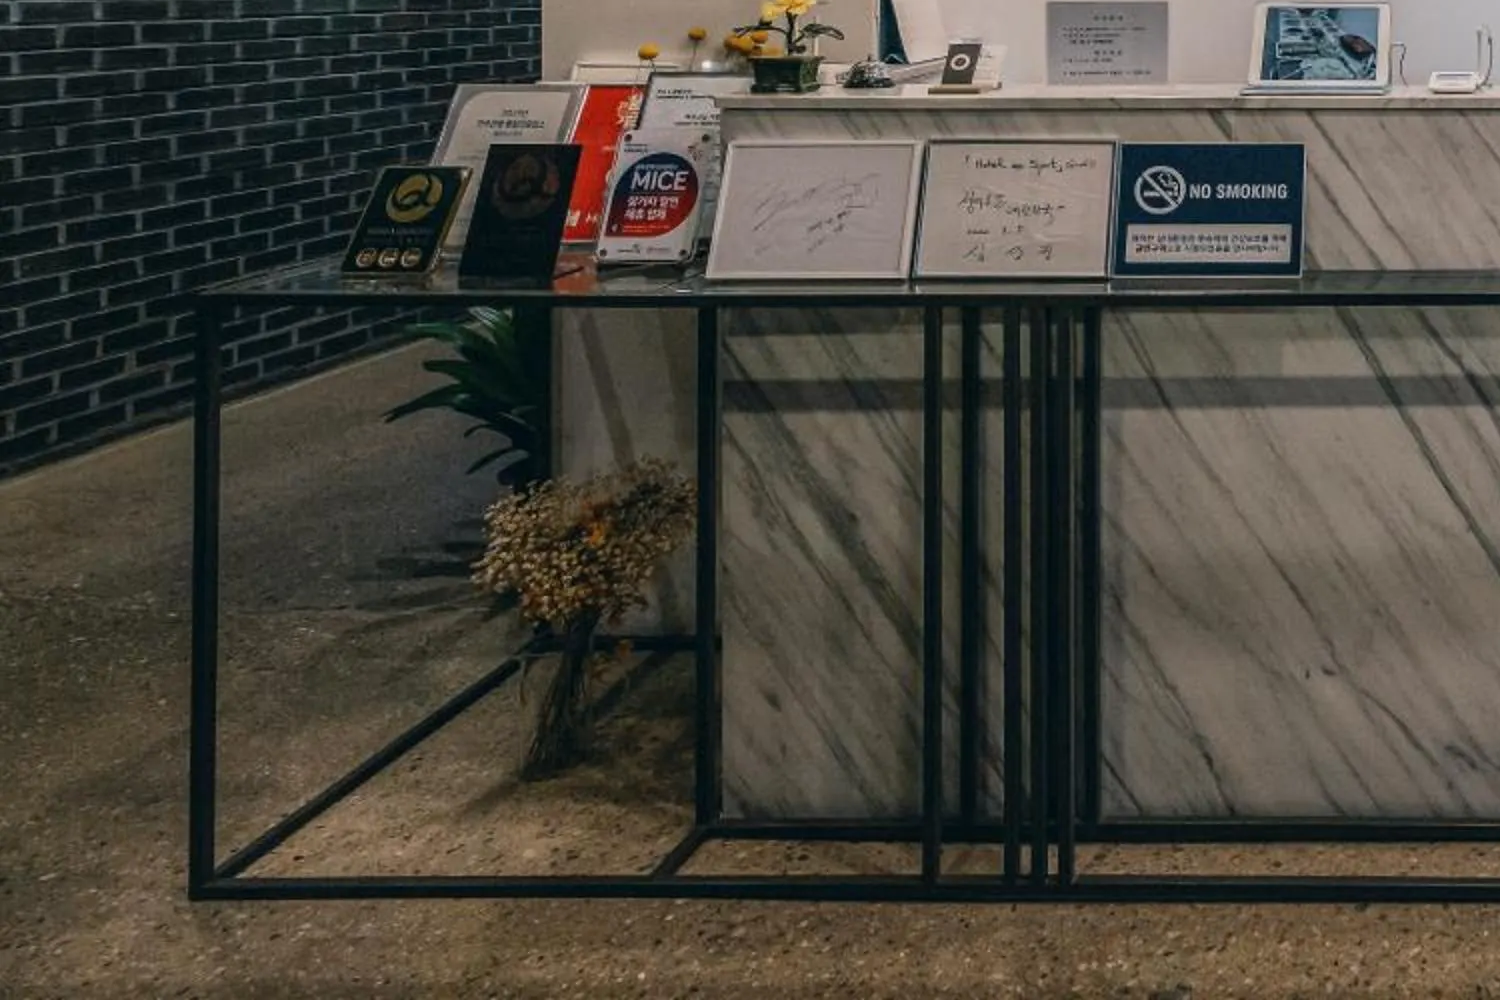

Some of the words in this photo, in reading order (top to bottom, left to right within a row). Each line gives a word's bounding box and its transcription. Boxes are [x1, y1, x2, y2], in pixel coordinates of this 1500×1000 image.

[631, 171, 689, 191] MICE
[1189, 183, 1212, 199] NO
[1216, 183, 1288, 199] SMOKING
